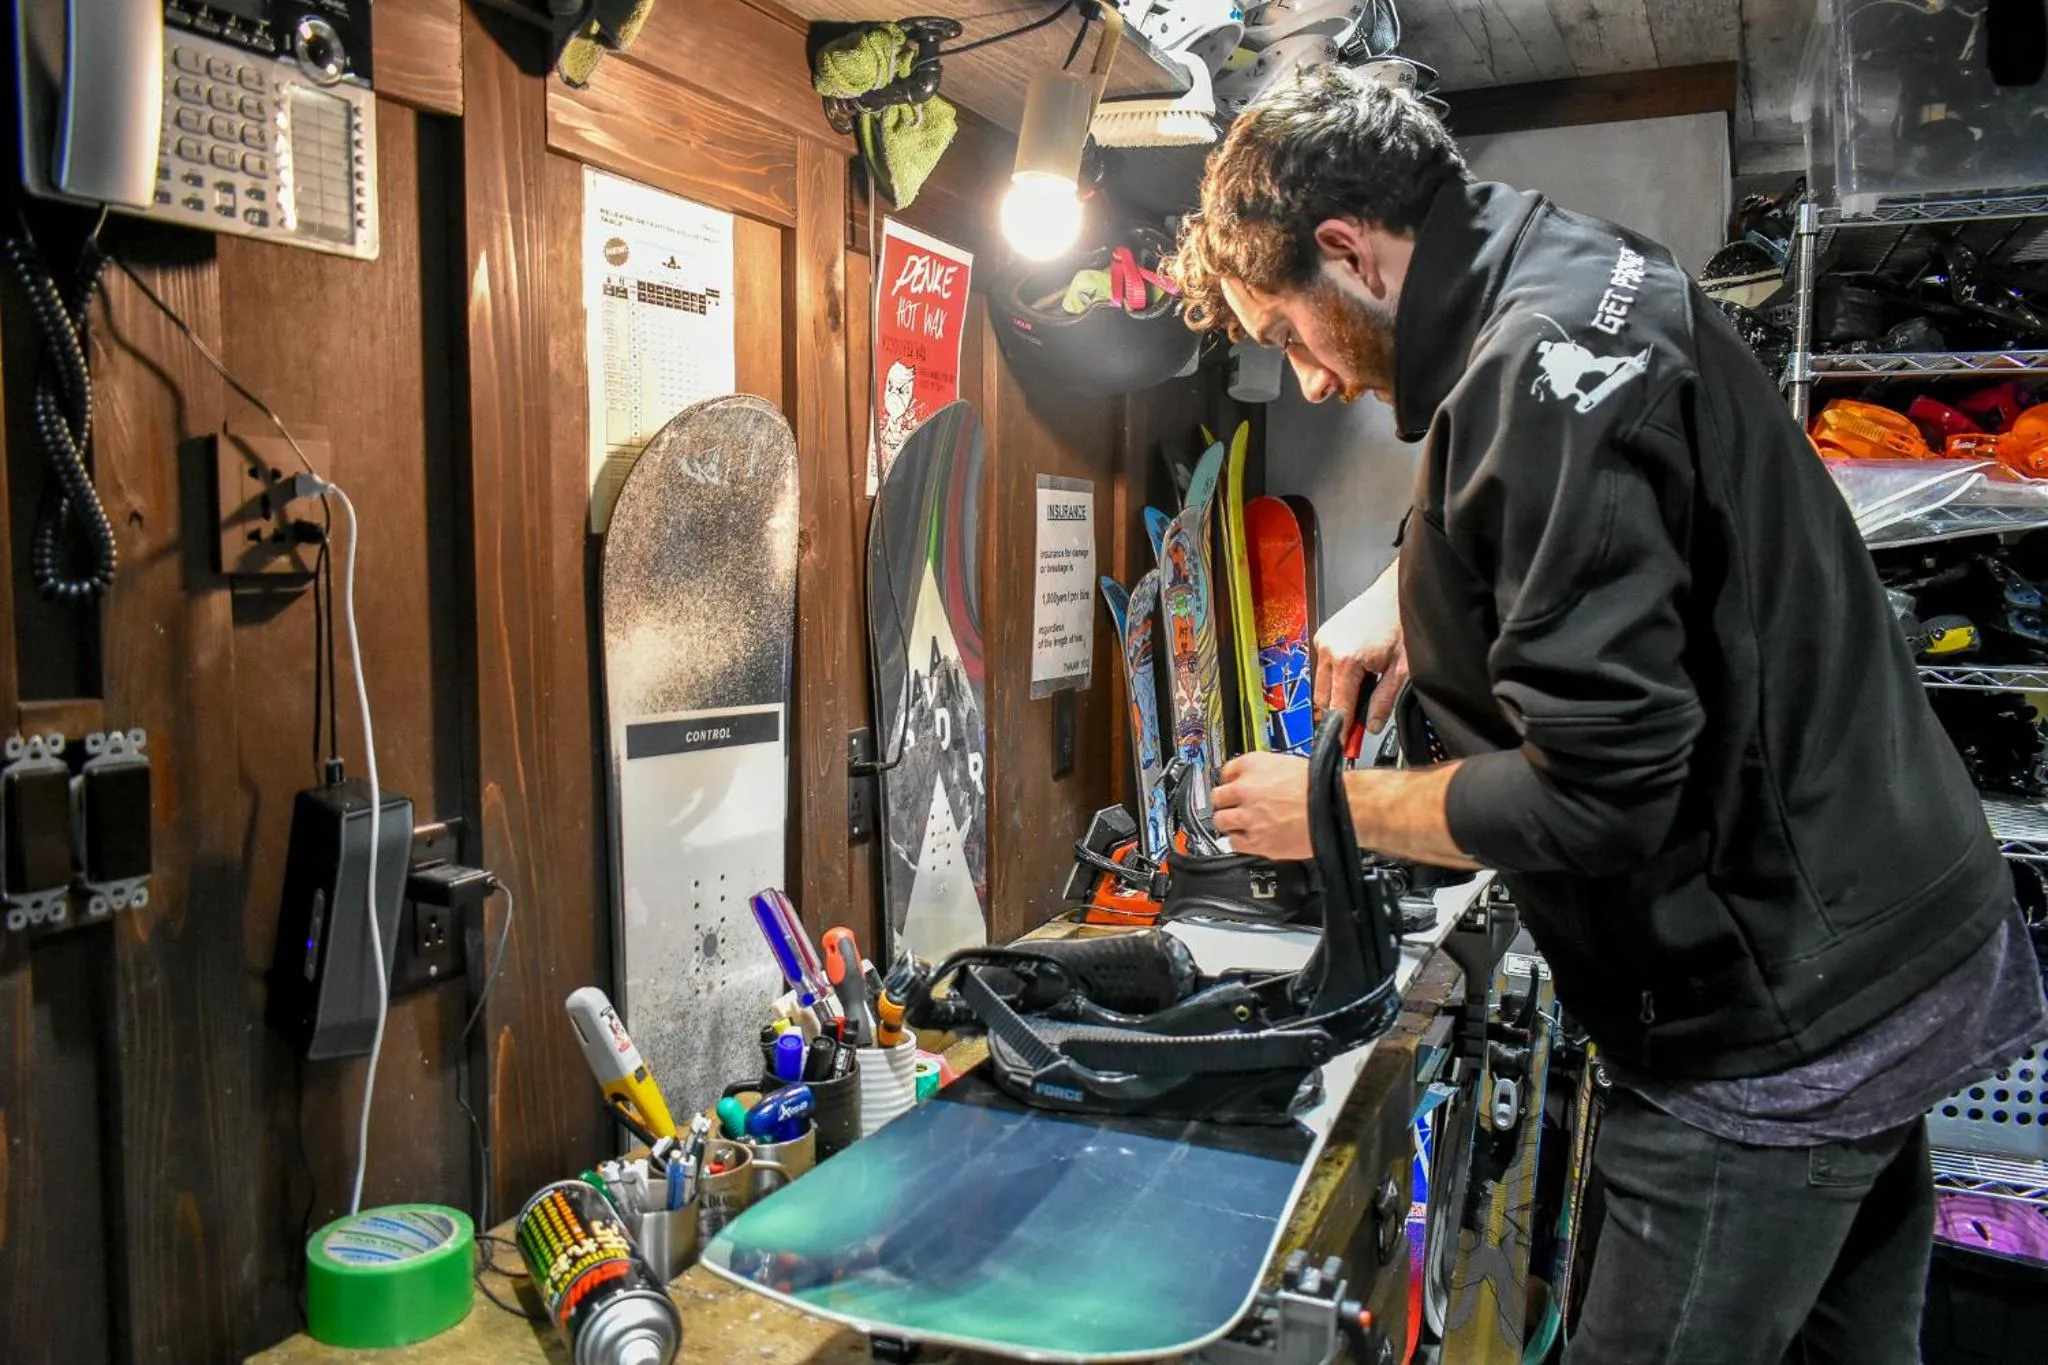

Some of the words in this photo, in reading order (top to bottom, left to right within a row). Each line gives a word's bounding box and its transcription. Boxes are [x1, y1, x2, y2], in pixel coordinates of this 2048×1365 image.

[896, 296, 921, 332] HOT
[923, 303, 947, 341] WAX
[1590, 288, 1635, 335] GET
[1046, 504, 1087, 520] INSURANCE
[685, 727, 732, 743] CONTROL
